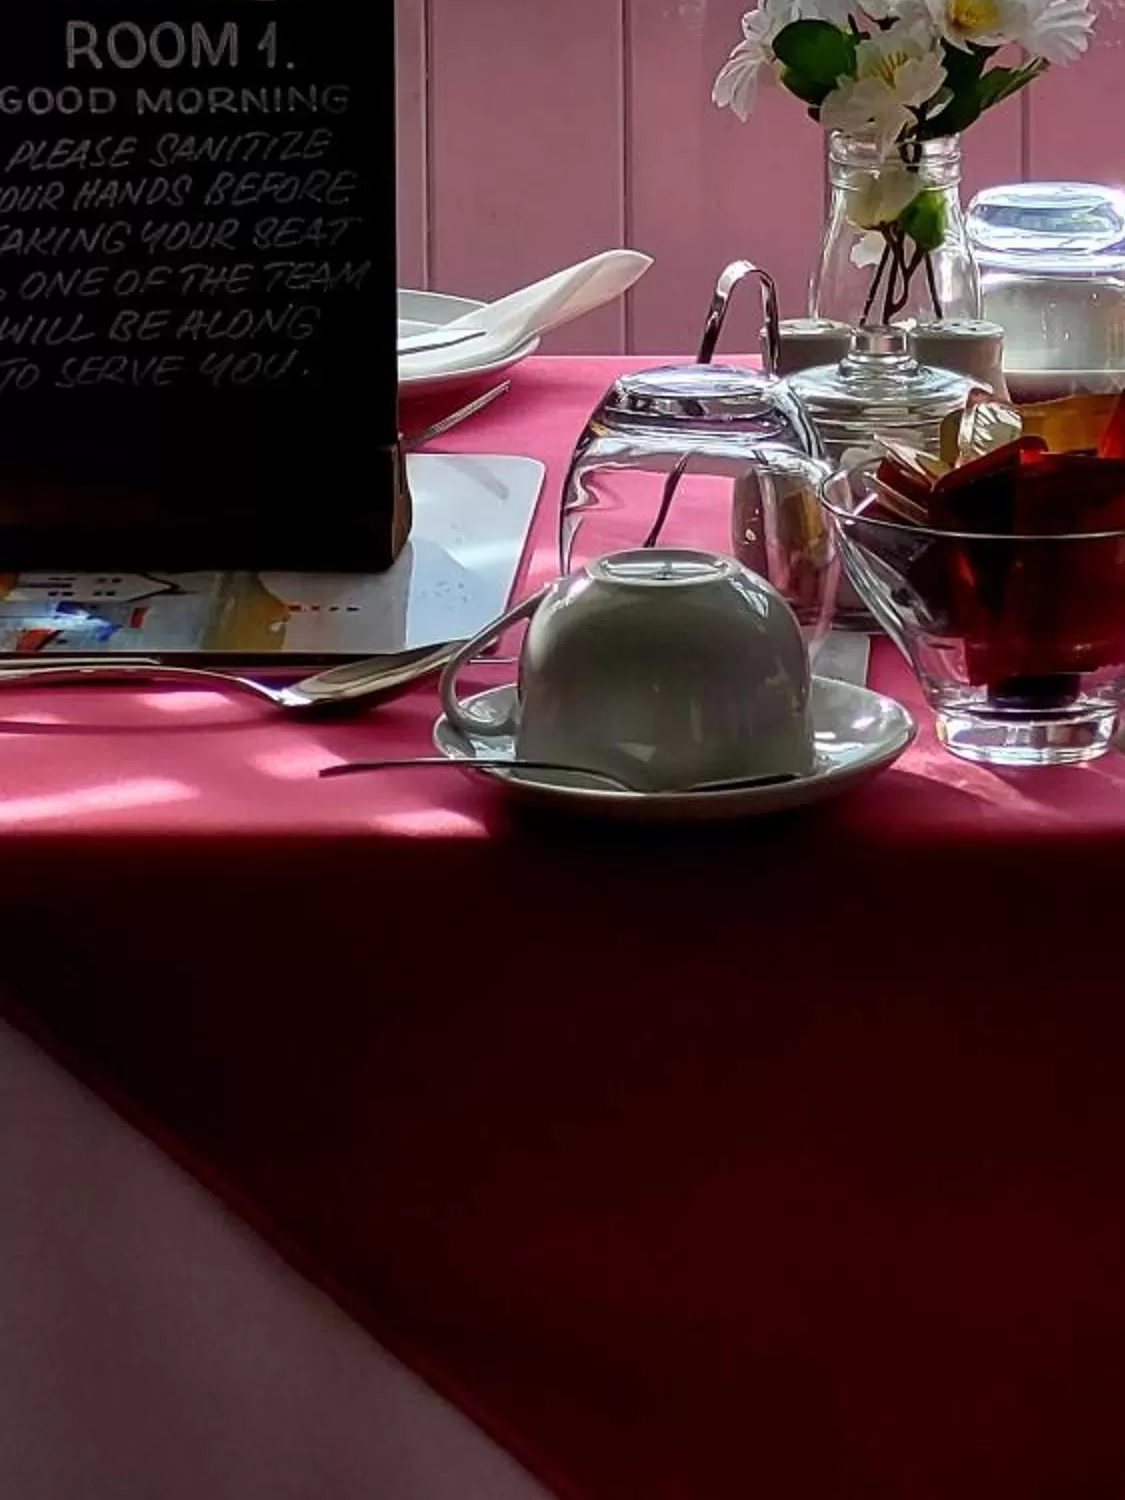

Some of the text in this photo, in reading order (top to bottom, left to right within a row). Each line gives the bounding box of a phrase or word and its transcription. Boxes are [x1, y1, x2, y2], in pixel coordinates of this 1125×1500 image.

[65, 19, 297, 70] ROOM 1.
[0, 83, 352, 116] GOOD MORNING
[4, 127, 333, 172] PLEASE SANITIZE
[0, 169, 359, 213] OUR HANDS BEFORE
[139, 217, 240, 252] YOUR
[252, 215, 364, 250] SEAT
[18, 266, 110, 301] ONE
[114, 266, 173, 297] OF
[178, 263, 255, 293] THE
[262, 260, 372, 292] TEAM
[0, 303, 322, 346] WILL BE ALONG
[54, 355, 184, 388] SERVE
[198, 349, 310, 388] YOU.
